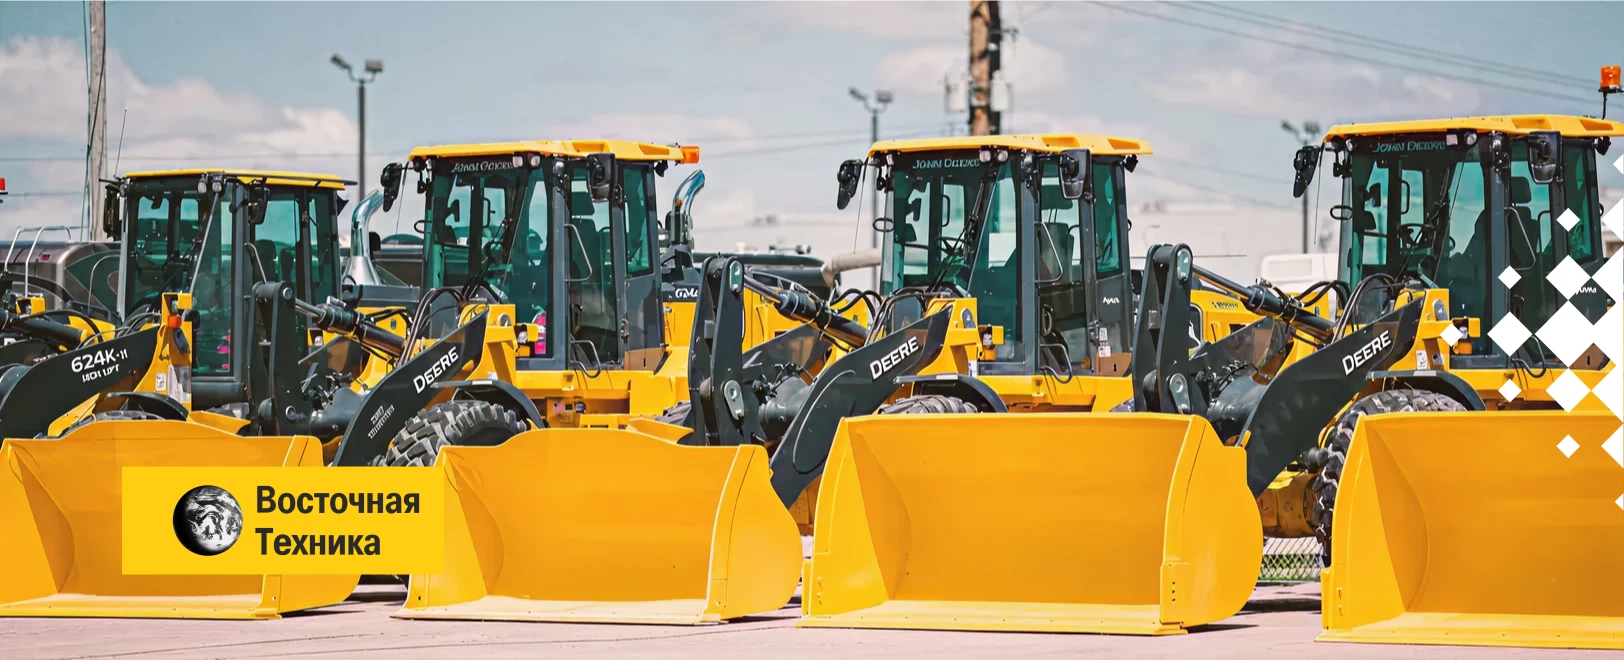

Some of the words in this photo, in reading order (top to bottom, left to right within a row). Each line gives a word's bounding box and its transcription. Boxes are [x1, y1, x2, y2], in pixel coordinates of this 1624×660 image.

[413, 346, 459, 394] DEERE
[869, 336, 919, 380] DEERE
[1342, 329, 1392, 376] DEERE
